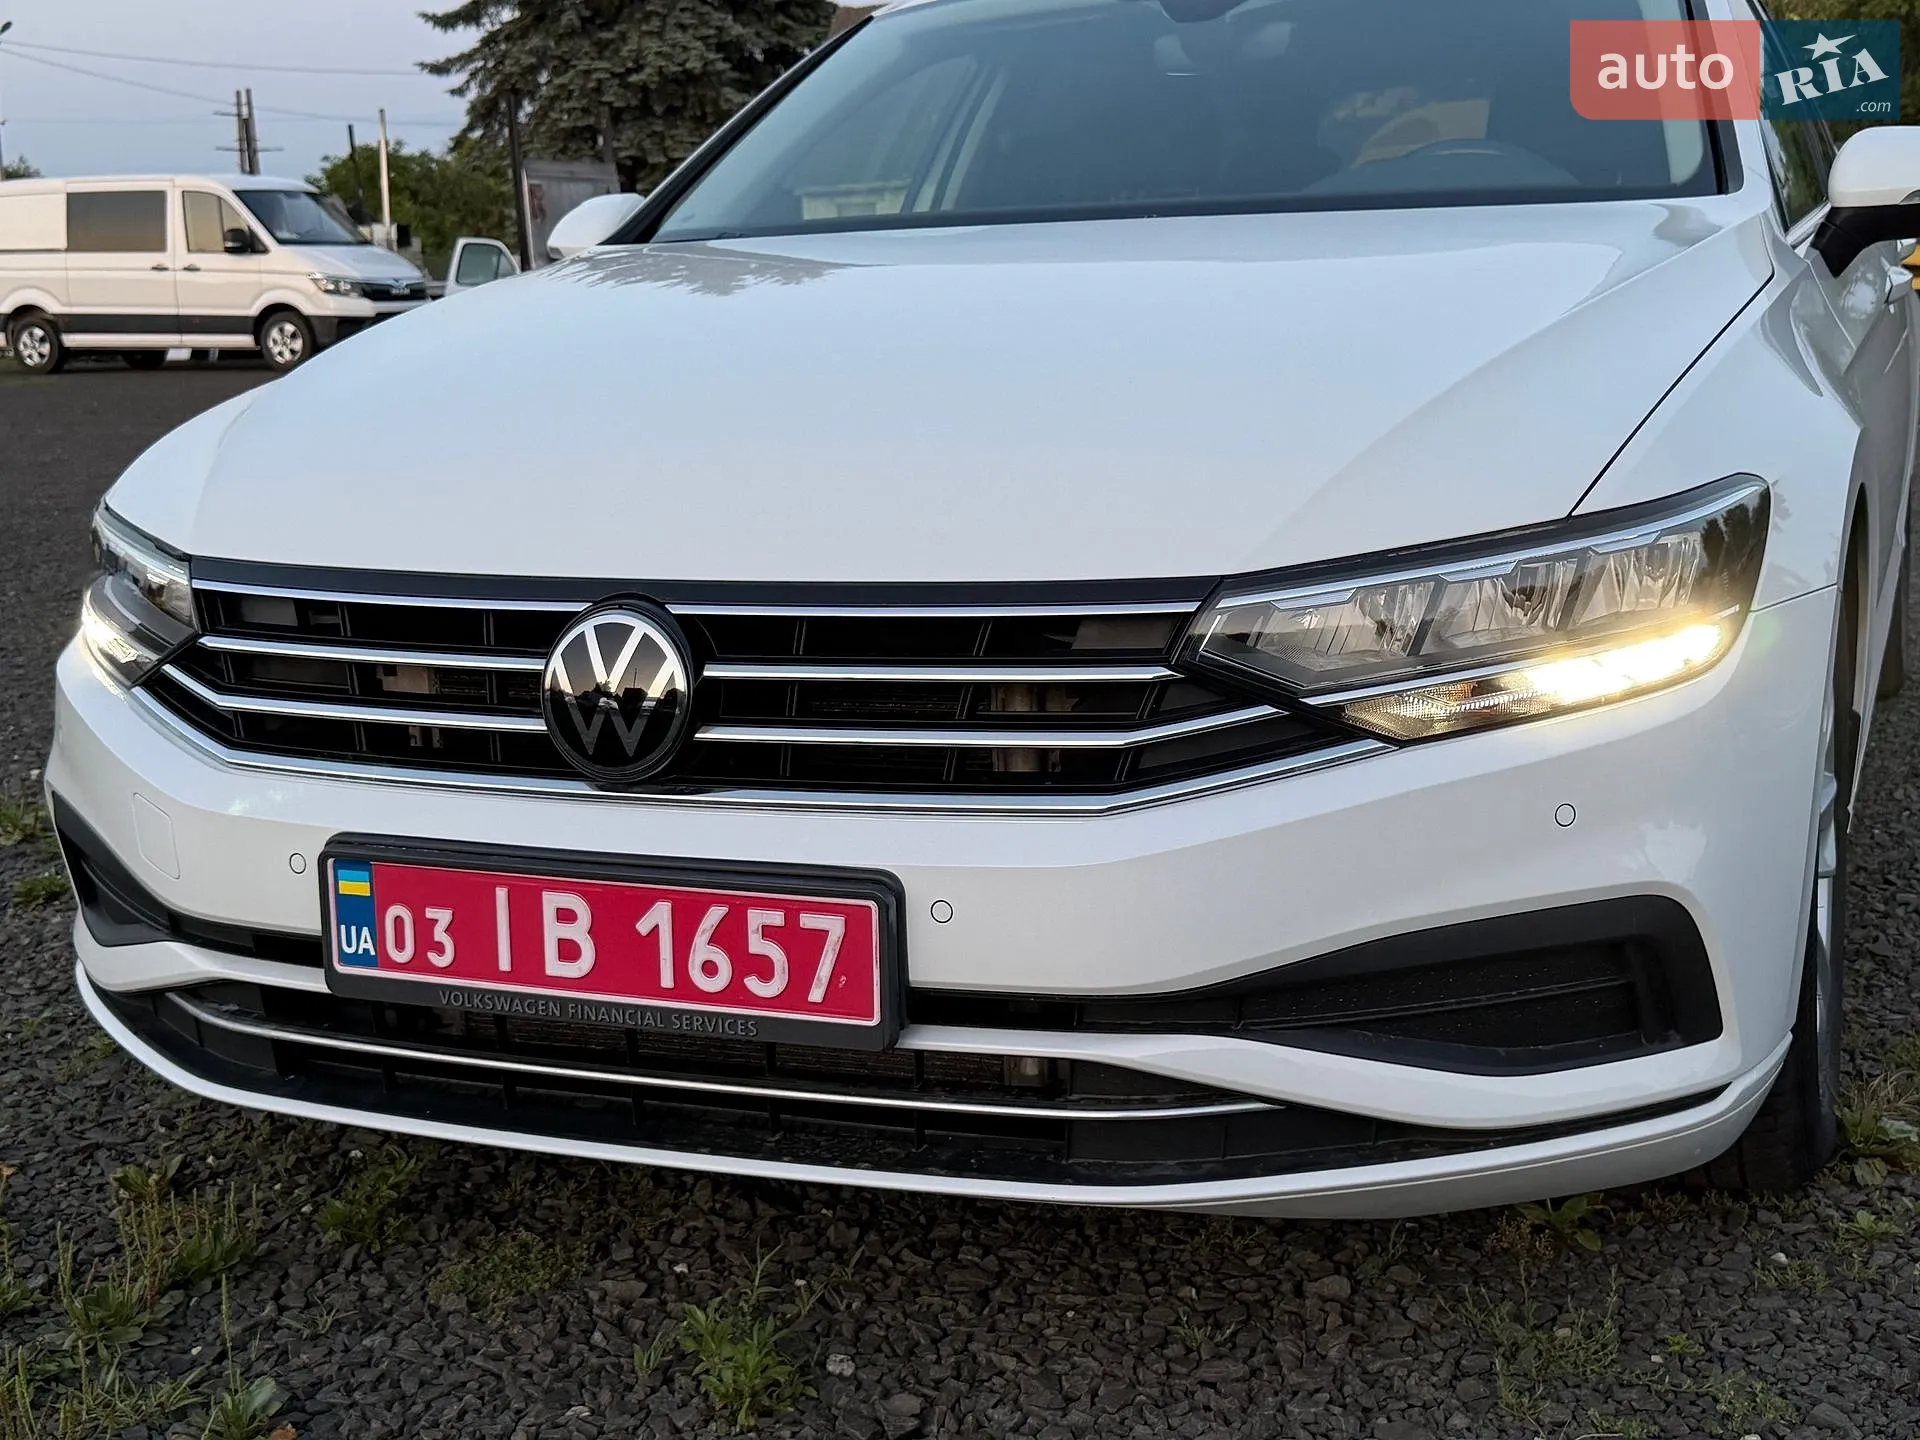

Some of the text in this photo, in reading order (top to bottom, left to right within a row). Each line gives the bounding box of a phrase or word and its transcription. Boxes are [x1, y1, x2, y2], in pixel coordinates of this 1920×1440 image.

[340, 924, 376, 956] UA
[384, 904, 455, 968] 03
[635, 900, 846, 1003] 1657
[439, 989, 758, 1037] VOLKSWAGEN FINANCIAL SERVICES
